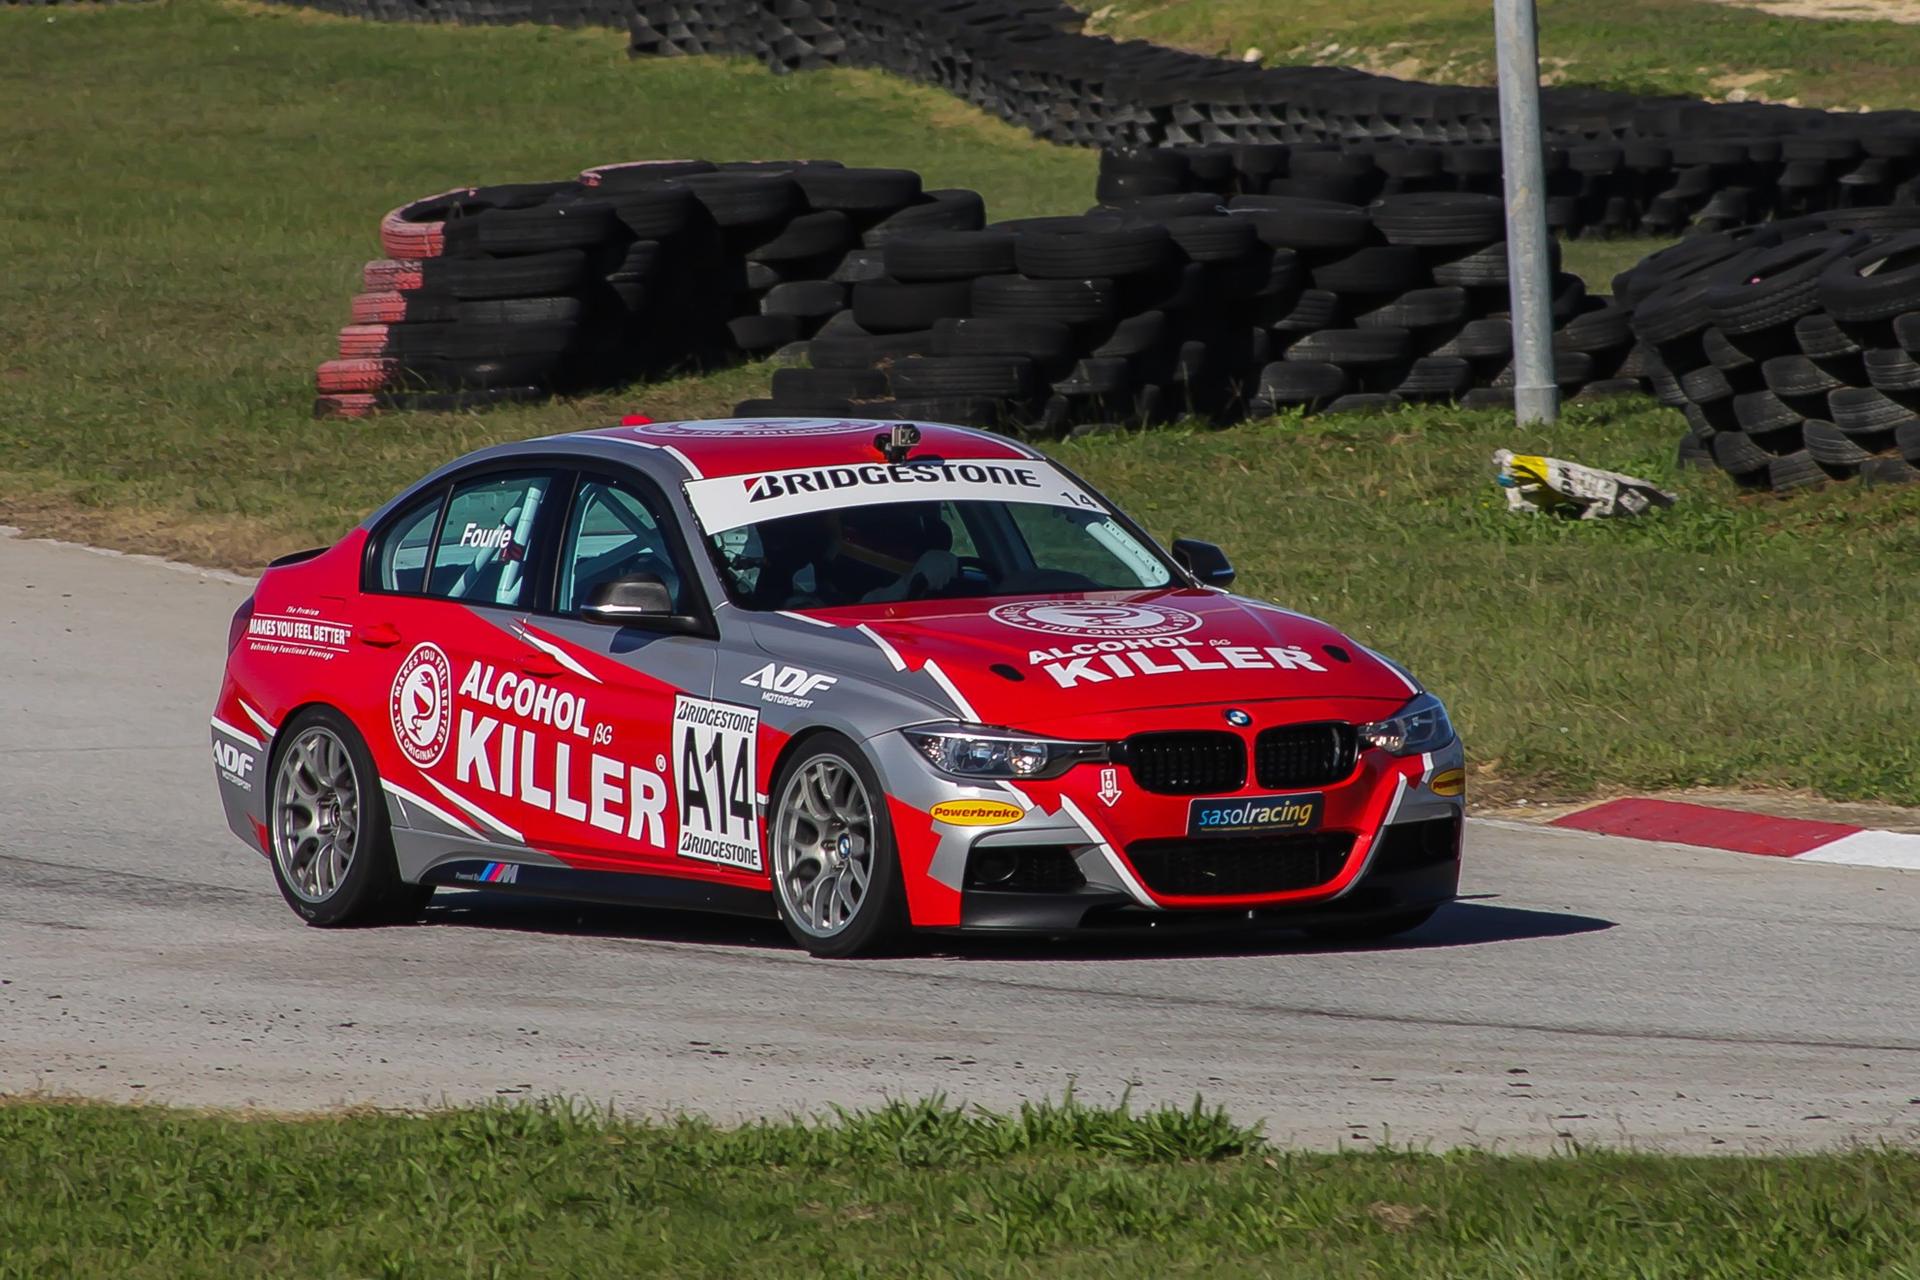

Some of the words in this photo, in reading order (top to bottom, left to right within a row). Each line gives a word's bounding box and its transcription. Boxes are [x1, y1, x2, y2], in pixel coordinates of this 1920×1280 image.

[743, 464, 1042, 503] BRIDGESTONE
[1060, 491, 1097, 509] 14
[460, 522, 512, 548] Fourie
[249, 618, 276, 636] MAKES
[277, 621, 294, 638] YOU
[294, 623, 313, 640] FEEL
[420, 649, 435, 662] YOU
[1028, 636, 1204, 665] ALCOHOL
[394, 655, 419, 698] MAKES
[434, 655, 445, 686] FEEL
[741, 663, 838, 697] ADF
[458, 660, 590, 738] ALCOHOL
[761, 691, 814, 709] MOTORSPORT
[436, 688, 448, 744] BETTER
[676, 701, 756, 734] BRIDGESTONE
[394, 713, 406, 740] THE
[403, 738, 436, 761] ORIGINAL
[212, 740, 254, 778] ADF
[683, 727, 755, 841] A14
[933, 807, 1020, 819] Powerbrake
[681, 832, 758, 866] BRIDGESTONE
